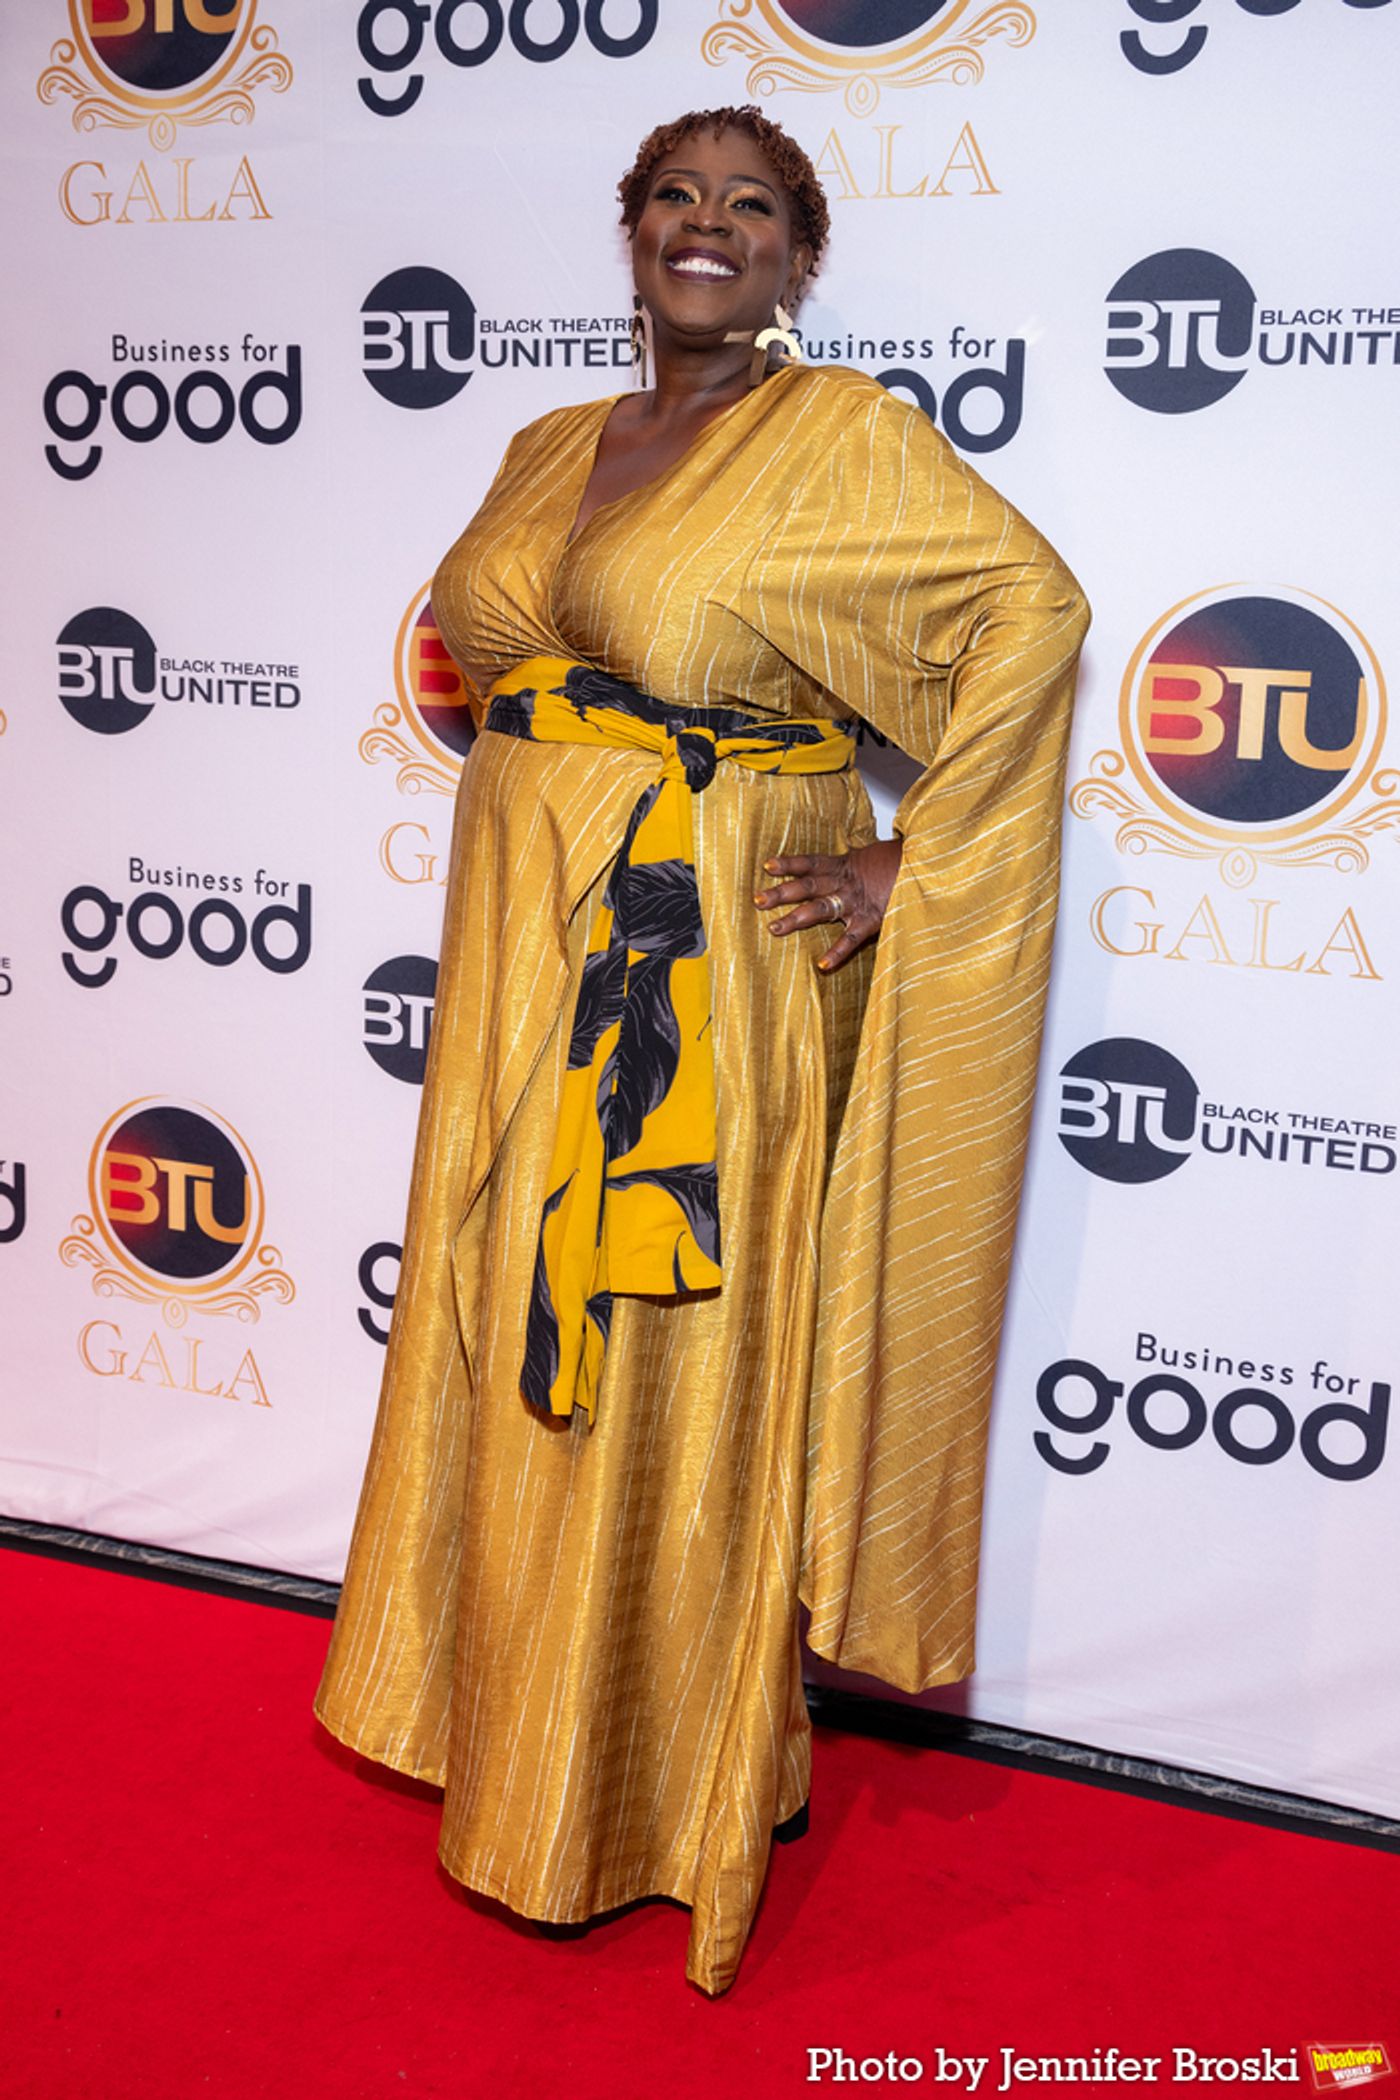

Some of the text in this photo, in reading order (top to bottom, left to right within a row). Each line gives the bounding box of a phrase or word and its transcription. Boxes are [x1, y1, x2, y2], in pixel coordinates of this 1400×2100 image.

[58, 155, 274, 226] GALA
[815, 121, 1002, 200] ALA
[112, 333, 278, 362] Business for
[360, 310, 476, 373] BTU
[480, 319, 543, 333] BLACK
[949, 326, 996, 359] for
[1103, 300, 1256, 372] BTU
[1258, 331, 1400, 365] UNIT
[1260, 309, 1343, 325] BLACK
[480, 338, 641, 367] UNITED
[43, 345, 302, 481] good
[56, 644, 157, 705] BTU
[160, 658, 299, 678] BLACK THEATRE
[161, 675, 301, 709] UNITED
[1137, 661, 1368, 771] BTU
[129, 857, 290, 897] Business for
[61, 884, 312, 988] good
[1089, 886, 1385, 981] GALA
[361, 990, 436, 1048] BT
[1057, 1075, 1200, 1154] BTU
[1203, 1103, 1397, 1140] BLACK THEATRE
[1201, 1122, 1397, 1174] UNITED
[101, 1151, 251, 1244] BTU
[77, 1319, 273, 1409] GALA
[1136, 1332, 1360, 1395] Business for
[1034, 1359, 1391, 1481] good
